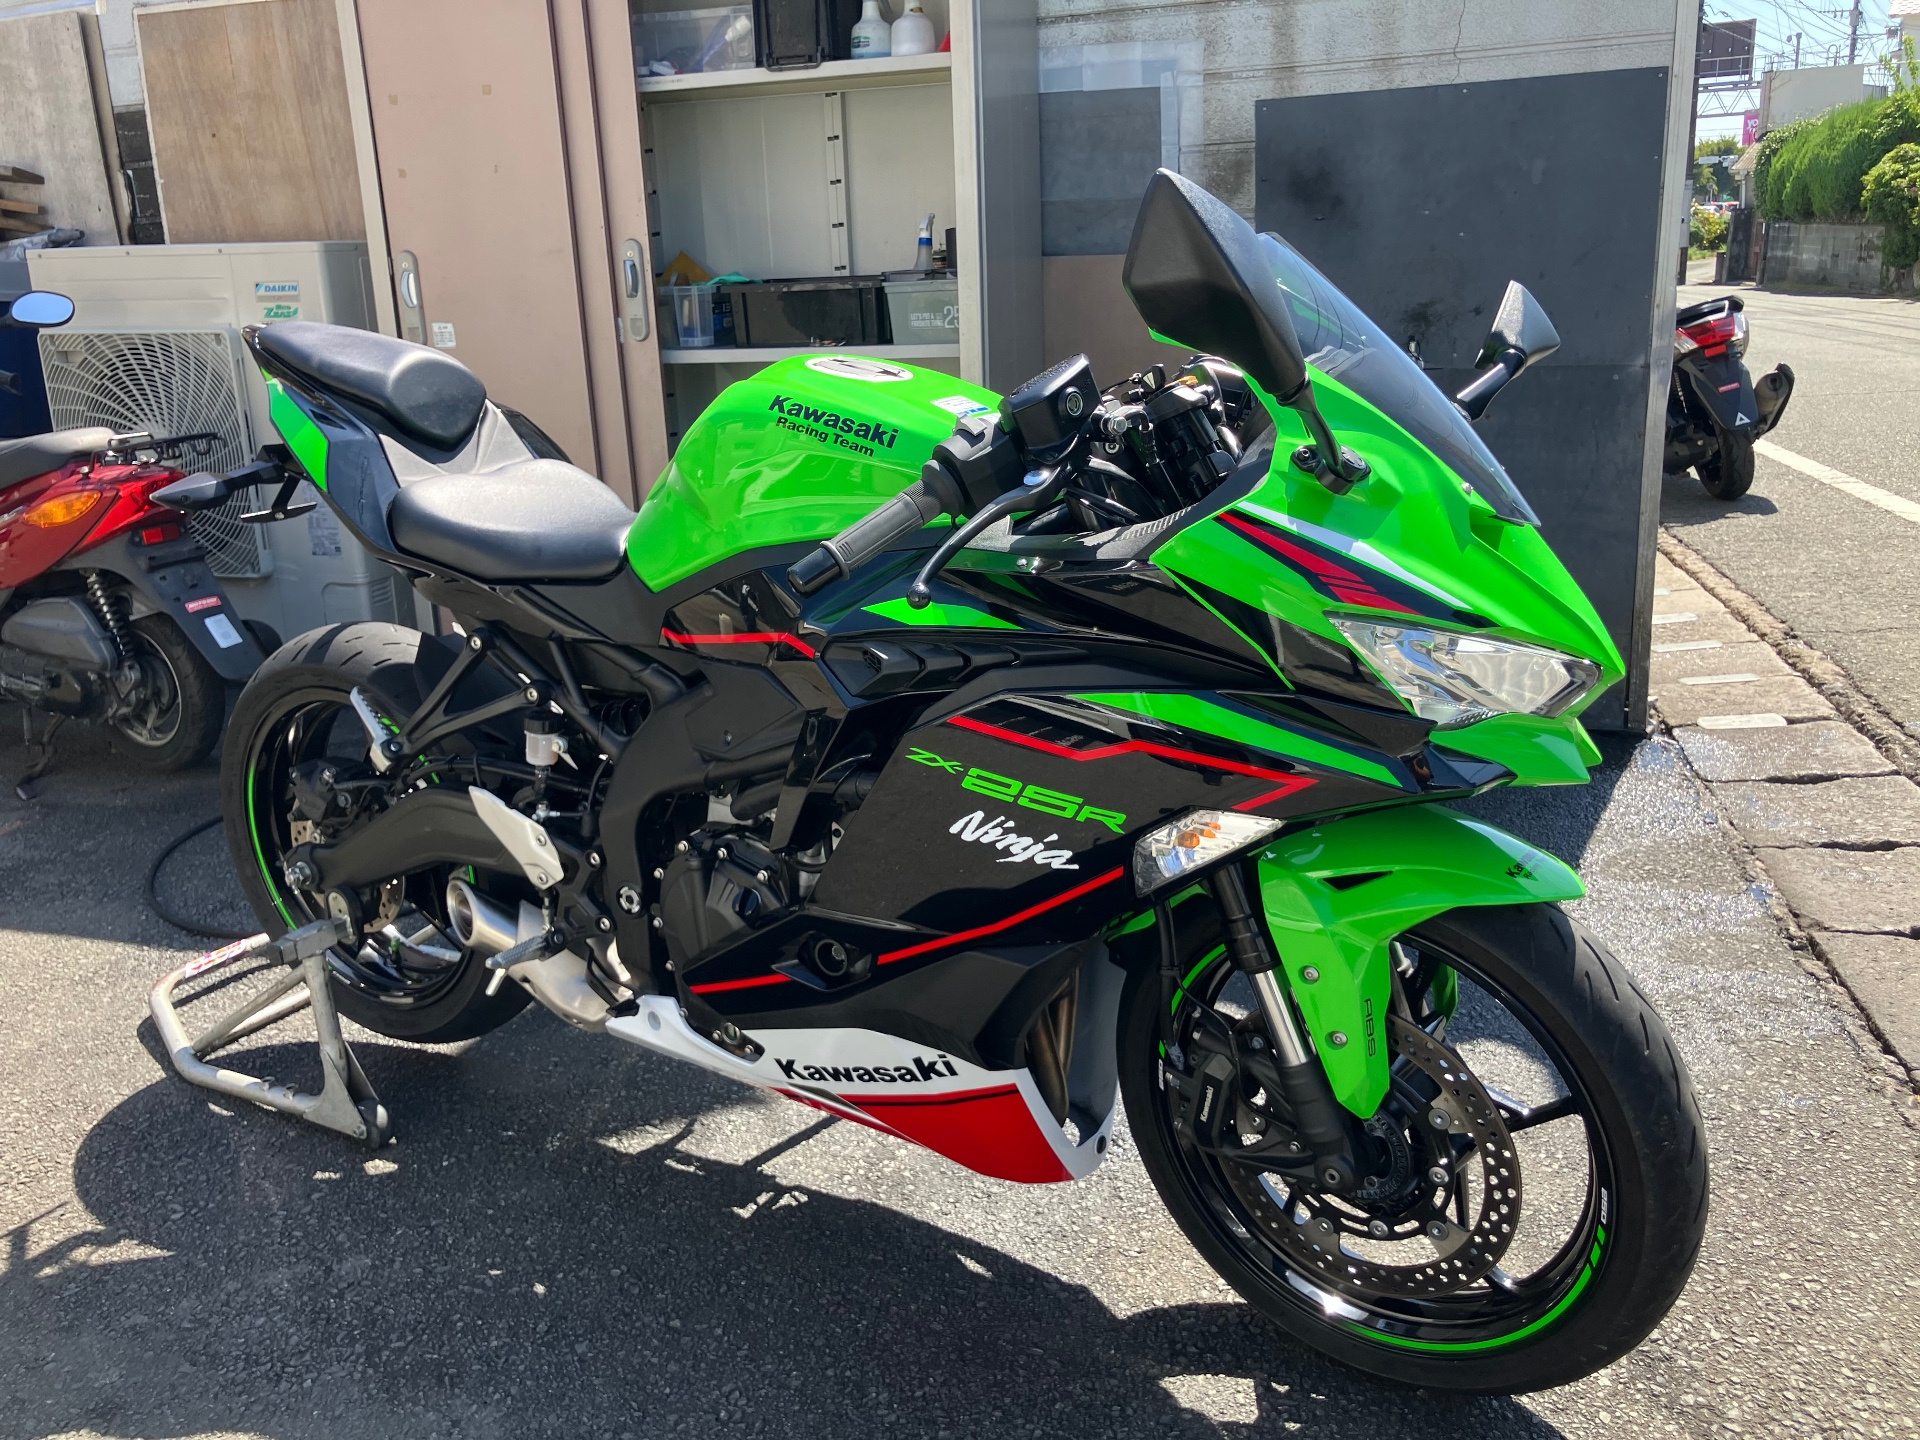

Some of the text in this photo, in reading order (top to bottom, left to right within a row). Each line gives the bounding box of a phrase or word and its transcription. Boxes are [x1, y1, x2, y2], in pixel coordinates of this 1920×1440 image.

[264, 284, 298, 293] DAIKIN
[768, 394, 900, 449] Kawasaki
[776, 416, 875, 457] Racing Team
[949, 810, 1079, 870] Ninja
[1364, 998, 1376, 1057] ABS
[774, 1053, 959, 1083] Kawasaki
[1200, 1085, 1214, 1123] Kawasaki
